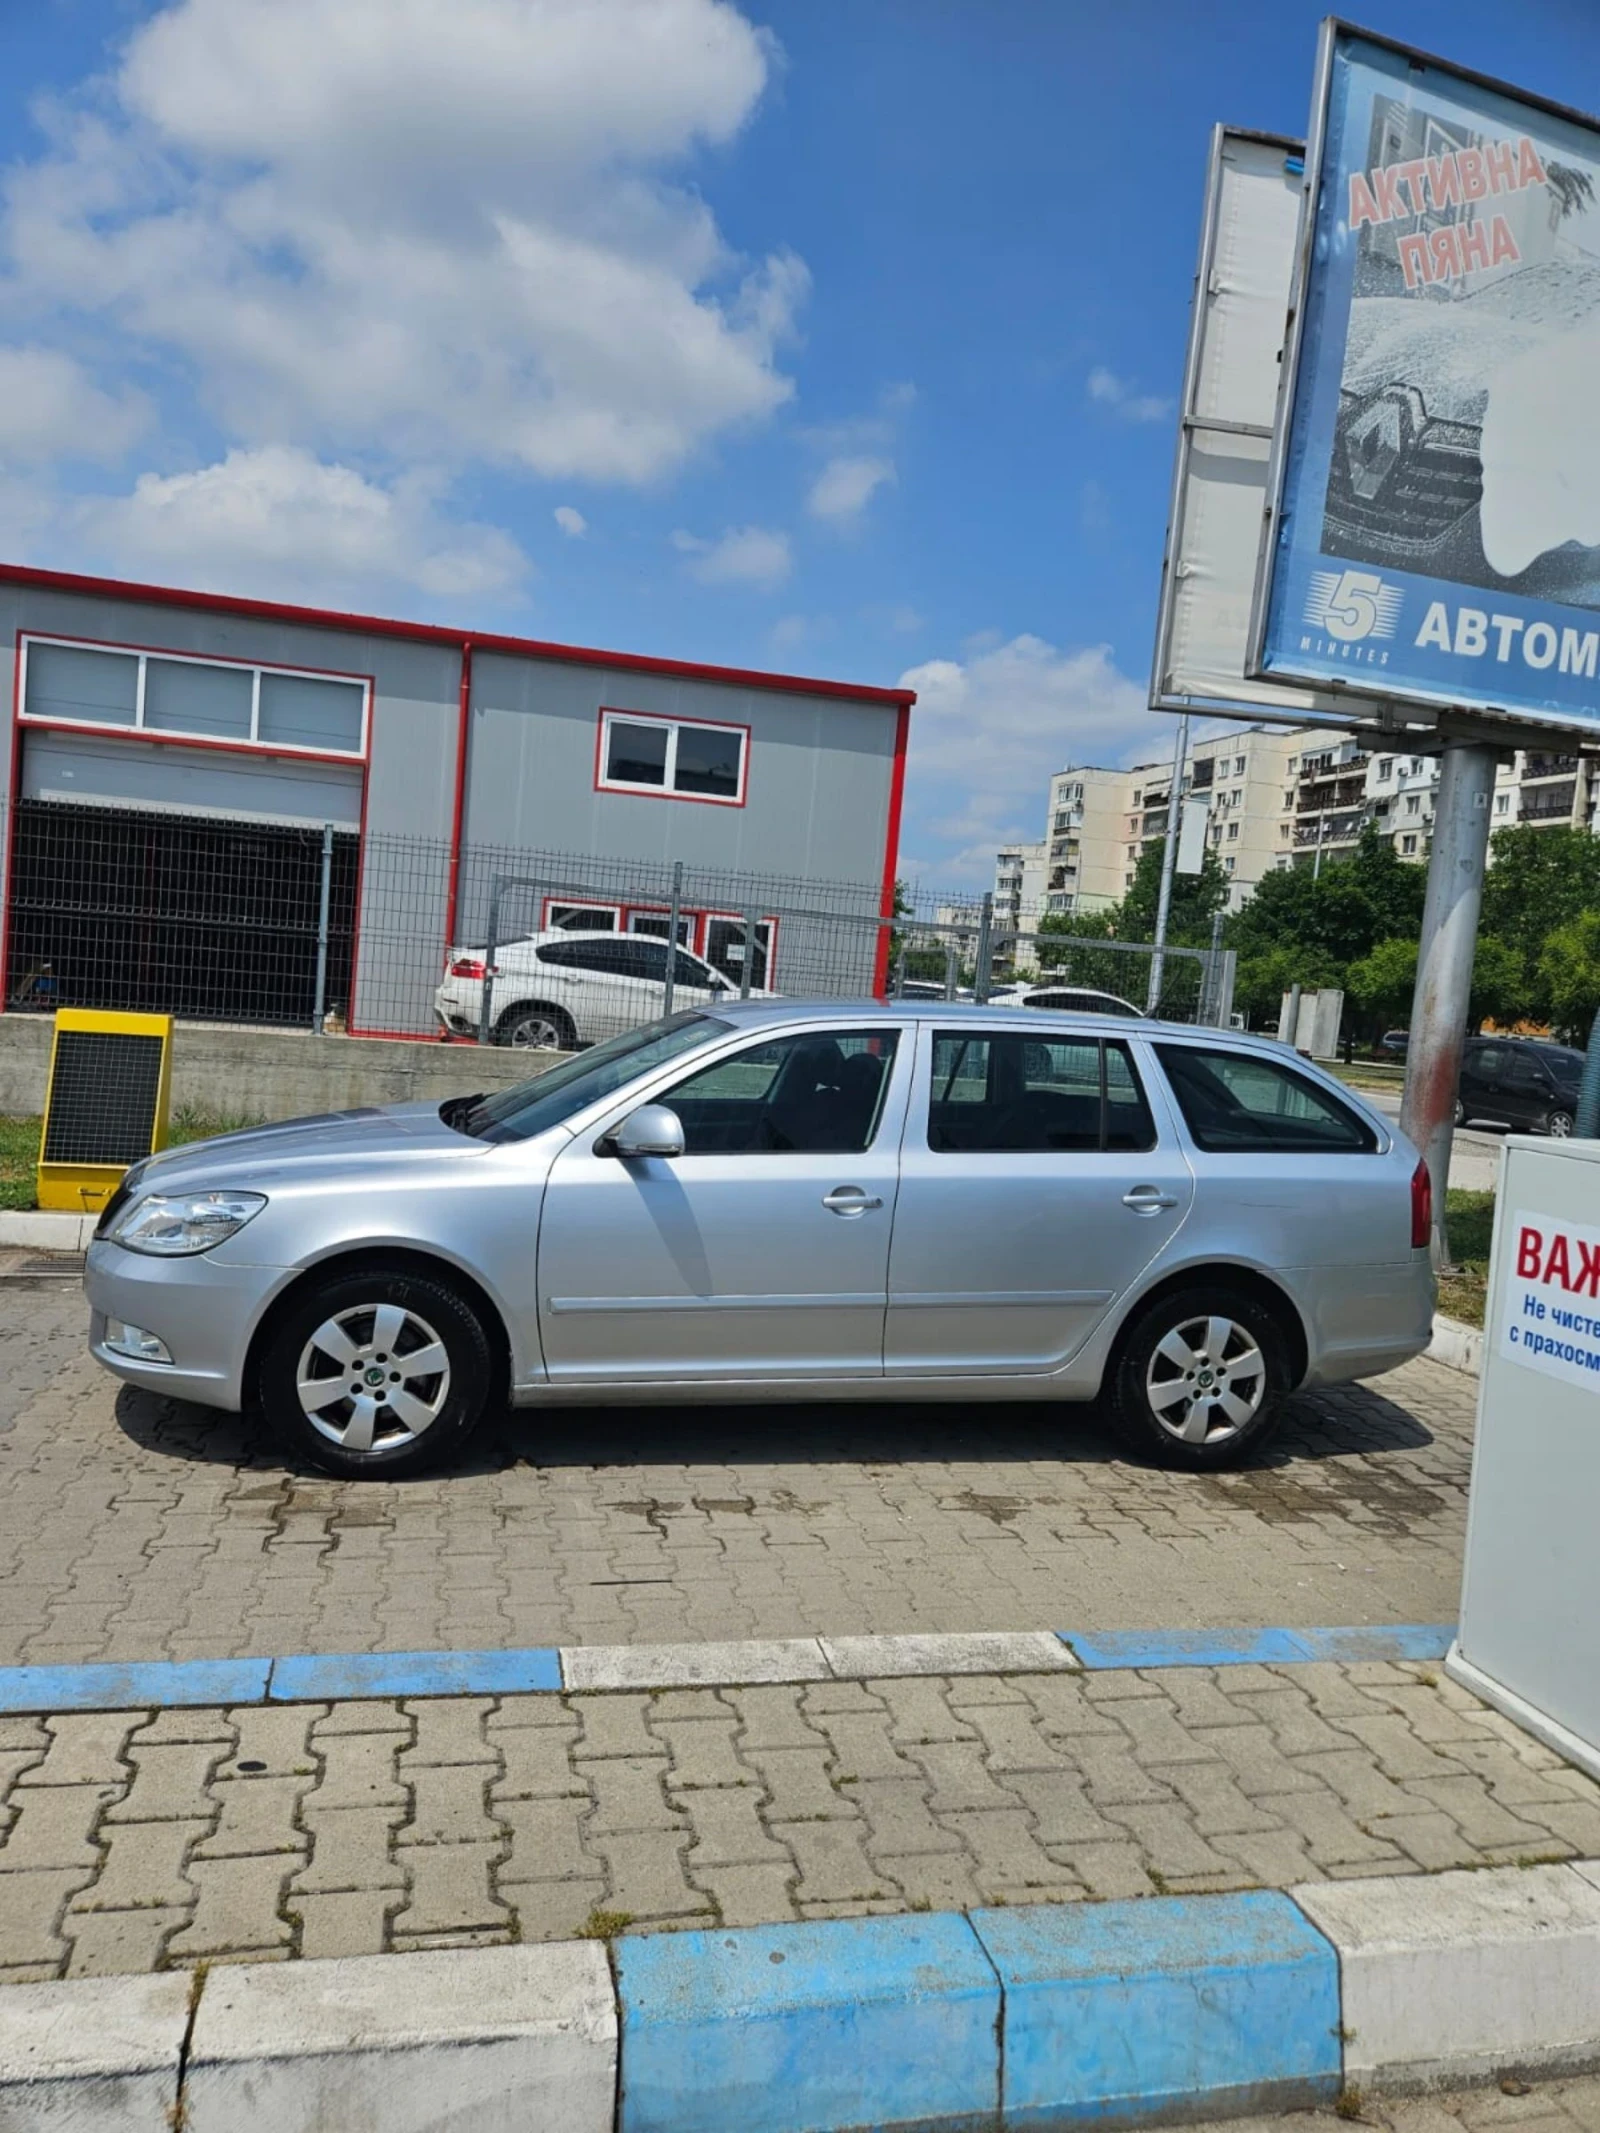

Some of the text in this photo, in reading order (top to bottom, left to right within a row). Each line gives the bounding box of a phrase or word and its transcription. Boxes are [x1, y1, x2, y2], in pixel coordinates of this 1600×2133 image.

[1350, 138, 1547, 229] АКТИВНА
[1397, 214, 1521, 289] ПЯНА
[1323, 570, 1382, 641] 5
[1414, 602, 1599, 678] АВТОМ
[1300, 636, 1389, 665] MINUTES
[1517, 1226, 1600, 1299] ВАЖ
[1509, 1326, 1600, 1371] с прахосм
[1523, 1294, 1600, 1338] Не чисте
